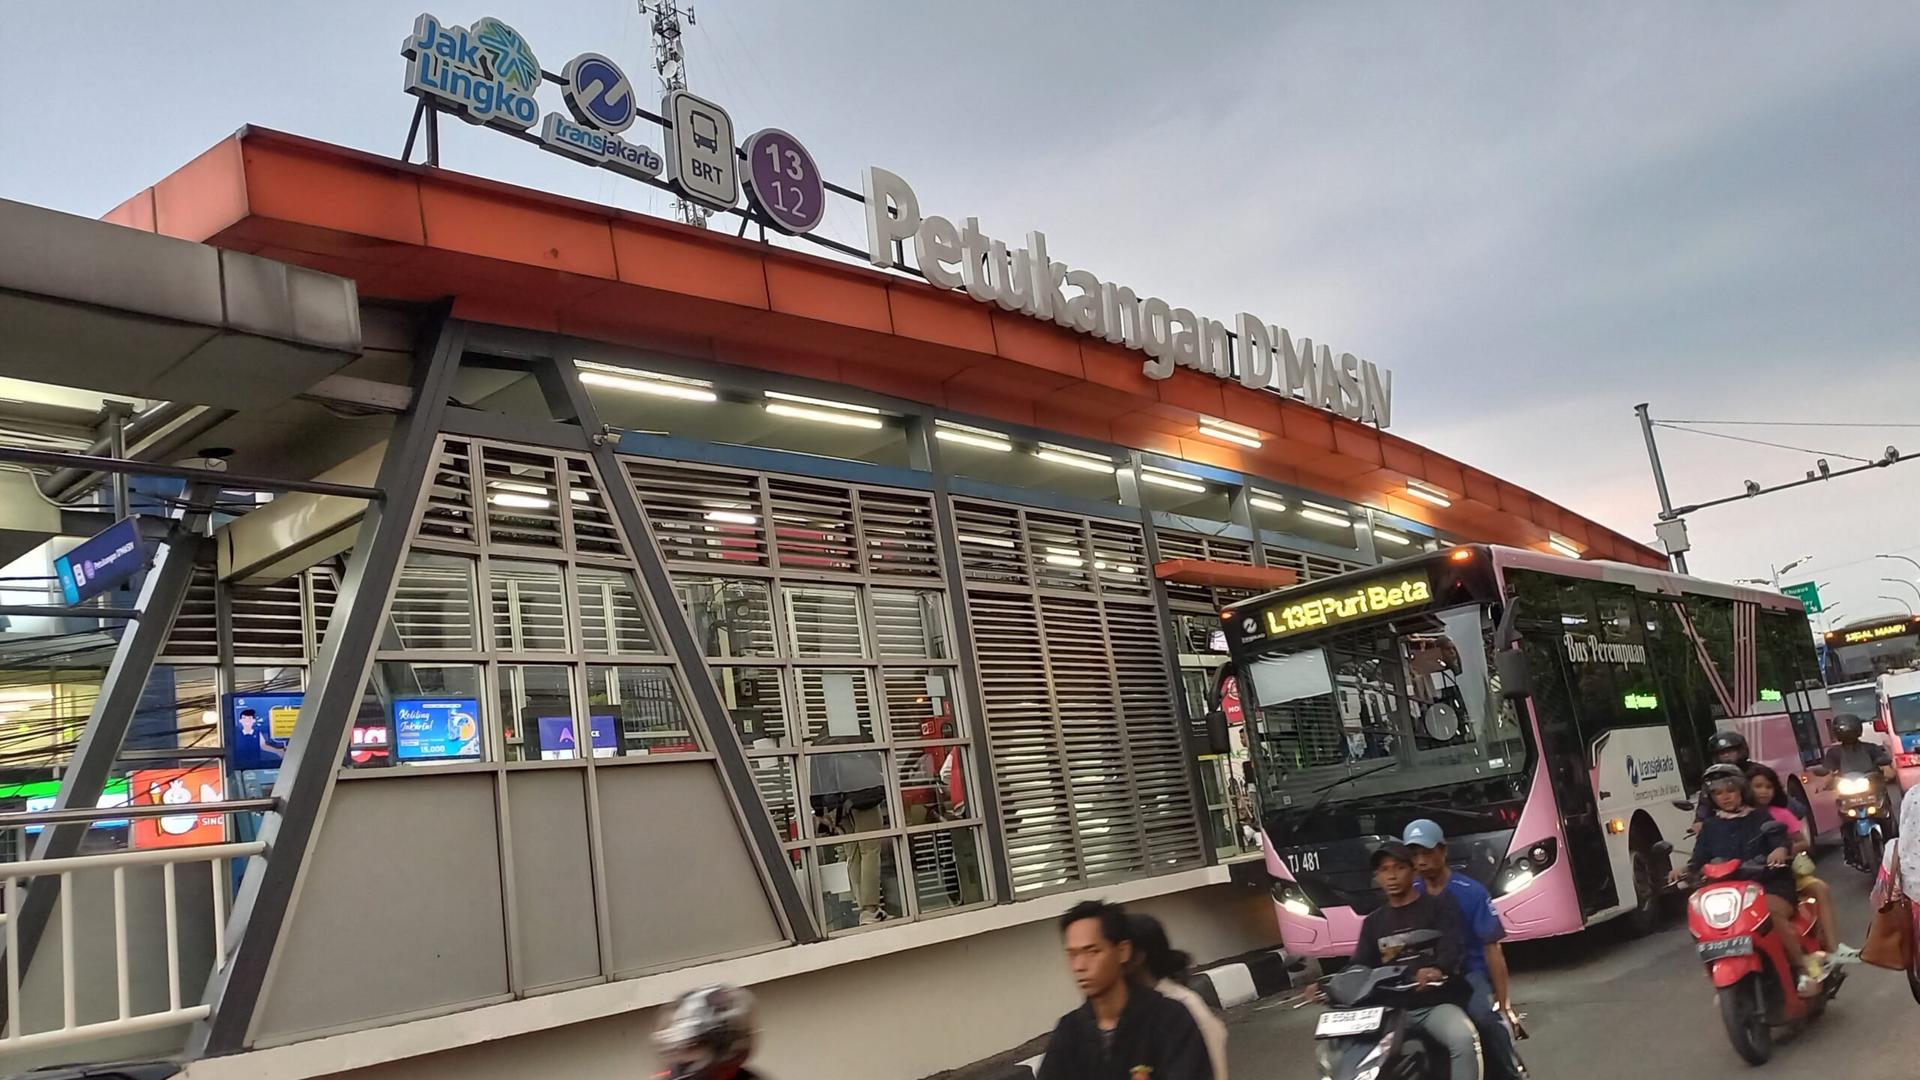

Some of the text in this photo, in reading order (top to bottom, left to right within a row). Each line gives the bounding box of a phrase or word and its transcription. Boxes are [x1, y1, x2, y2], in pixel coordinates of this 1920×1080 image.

[418, 19, 479, 69] Jak
[420, 52, 535, 123] Lingko
[555, 117, 661, 171] transjakarta
[765, 142, 804, 181] 13
[691, 158, 724, 187] BRT
[770, 181, 807, 219] 12
[863, 165, 1231, 380] Petukangan
[1318, 590, 1369, 625] Puri
[1367, 580, 1430, 611] Beta
[1563, 633, 1646, 671] Bus Perempuan
[1287, 851, 1321, 873] TJ 481
